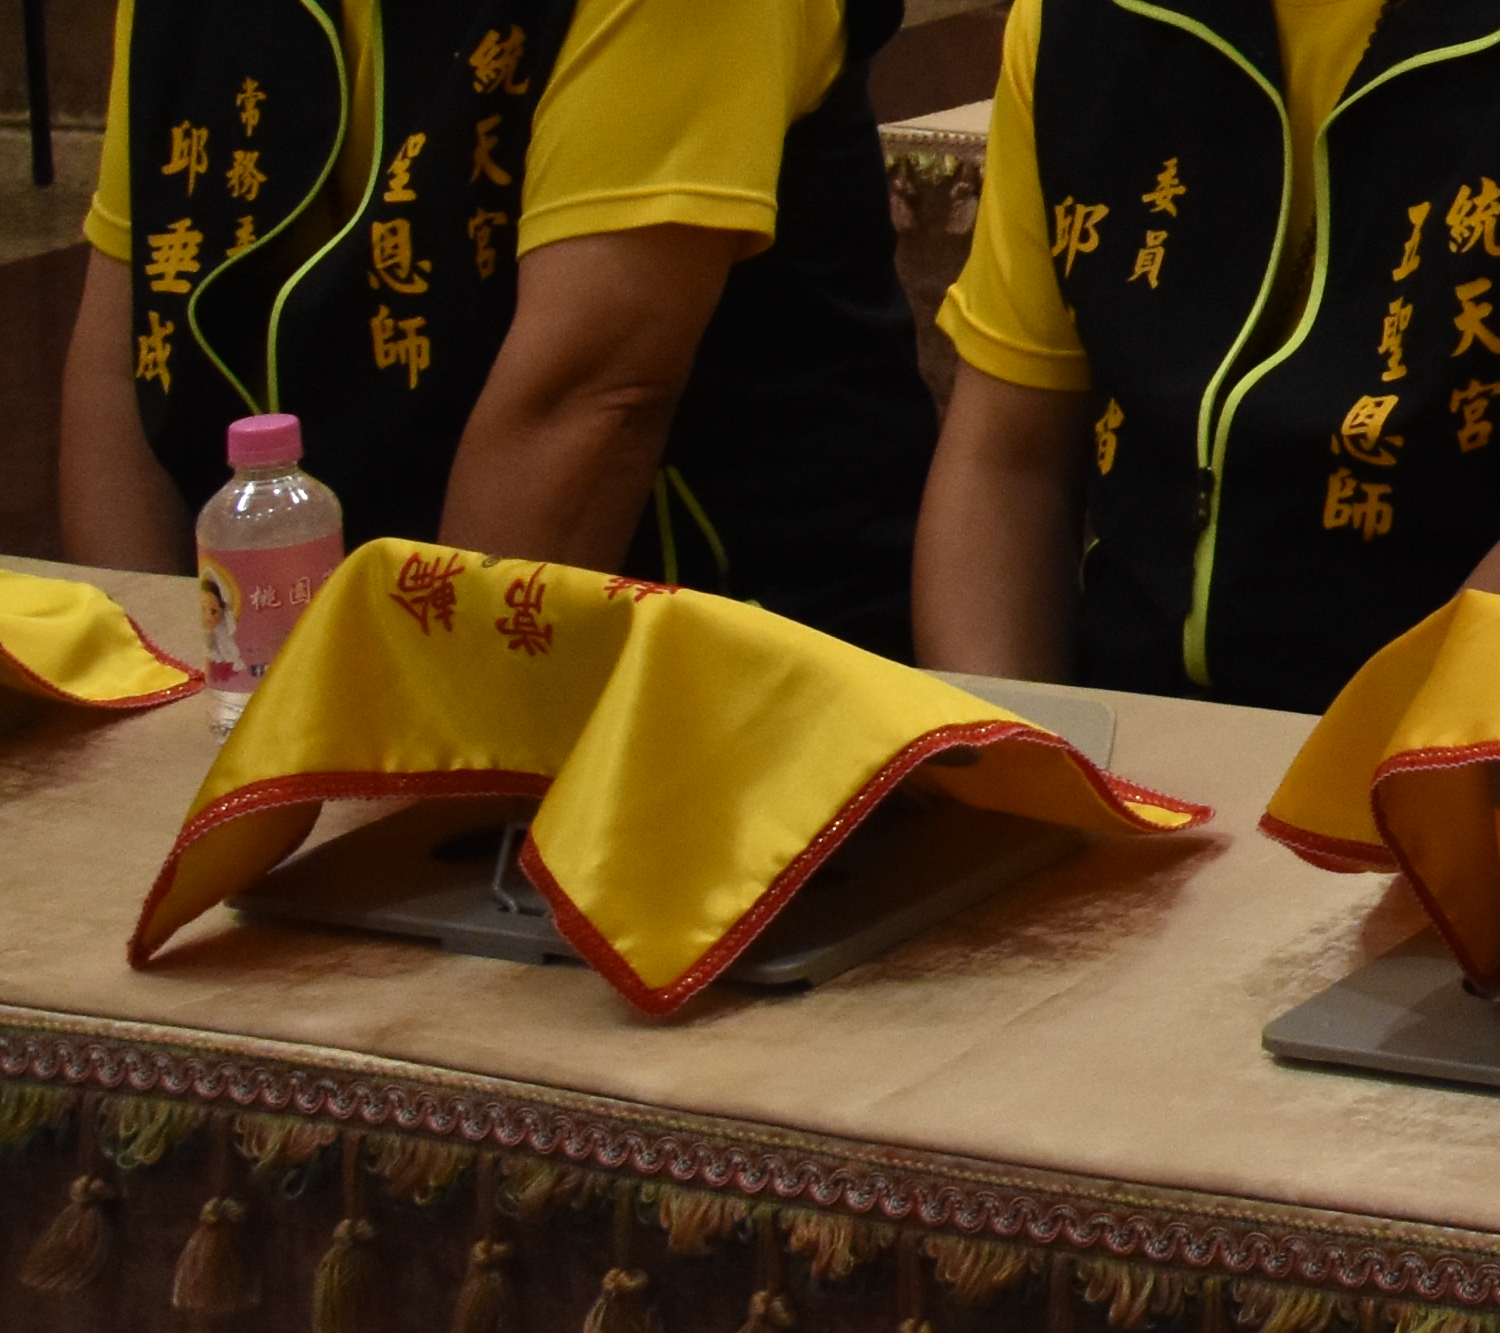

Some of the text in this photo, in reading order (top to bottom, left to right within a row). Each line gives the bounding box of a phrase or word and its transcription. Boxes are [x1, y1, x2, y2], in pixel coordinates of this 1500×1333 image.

[468, 24, 530, 279] 統天宮
[1127, 157, 1187, 289] 委員
